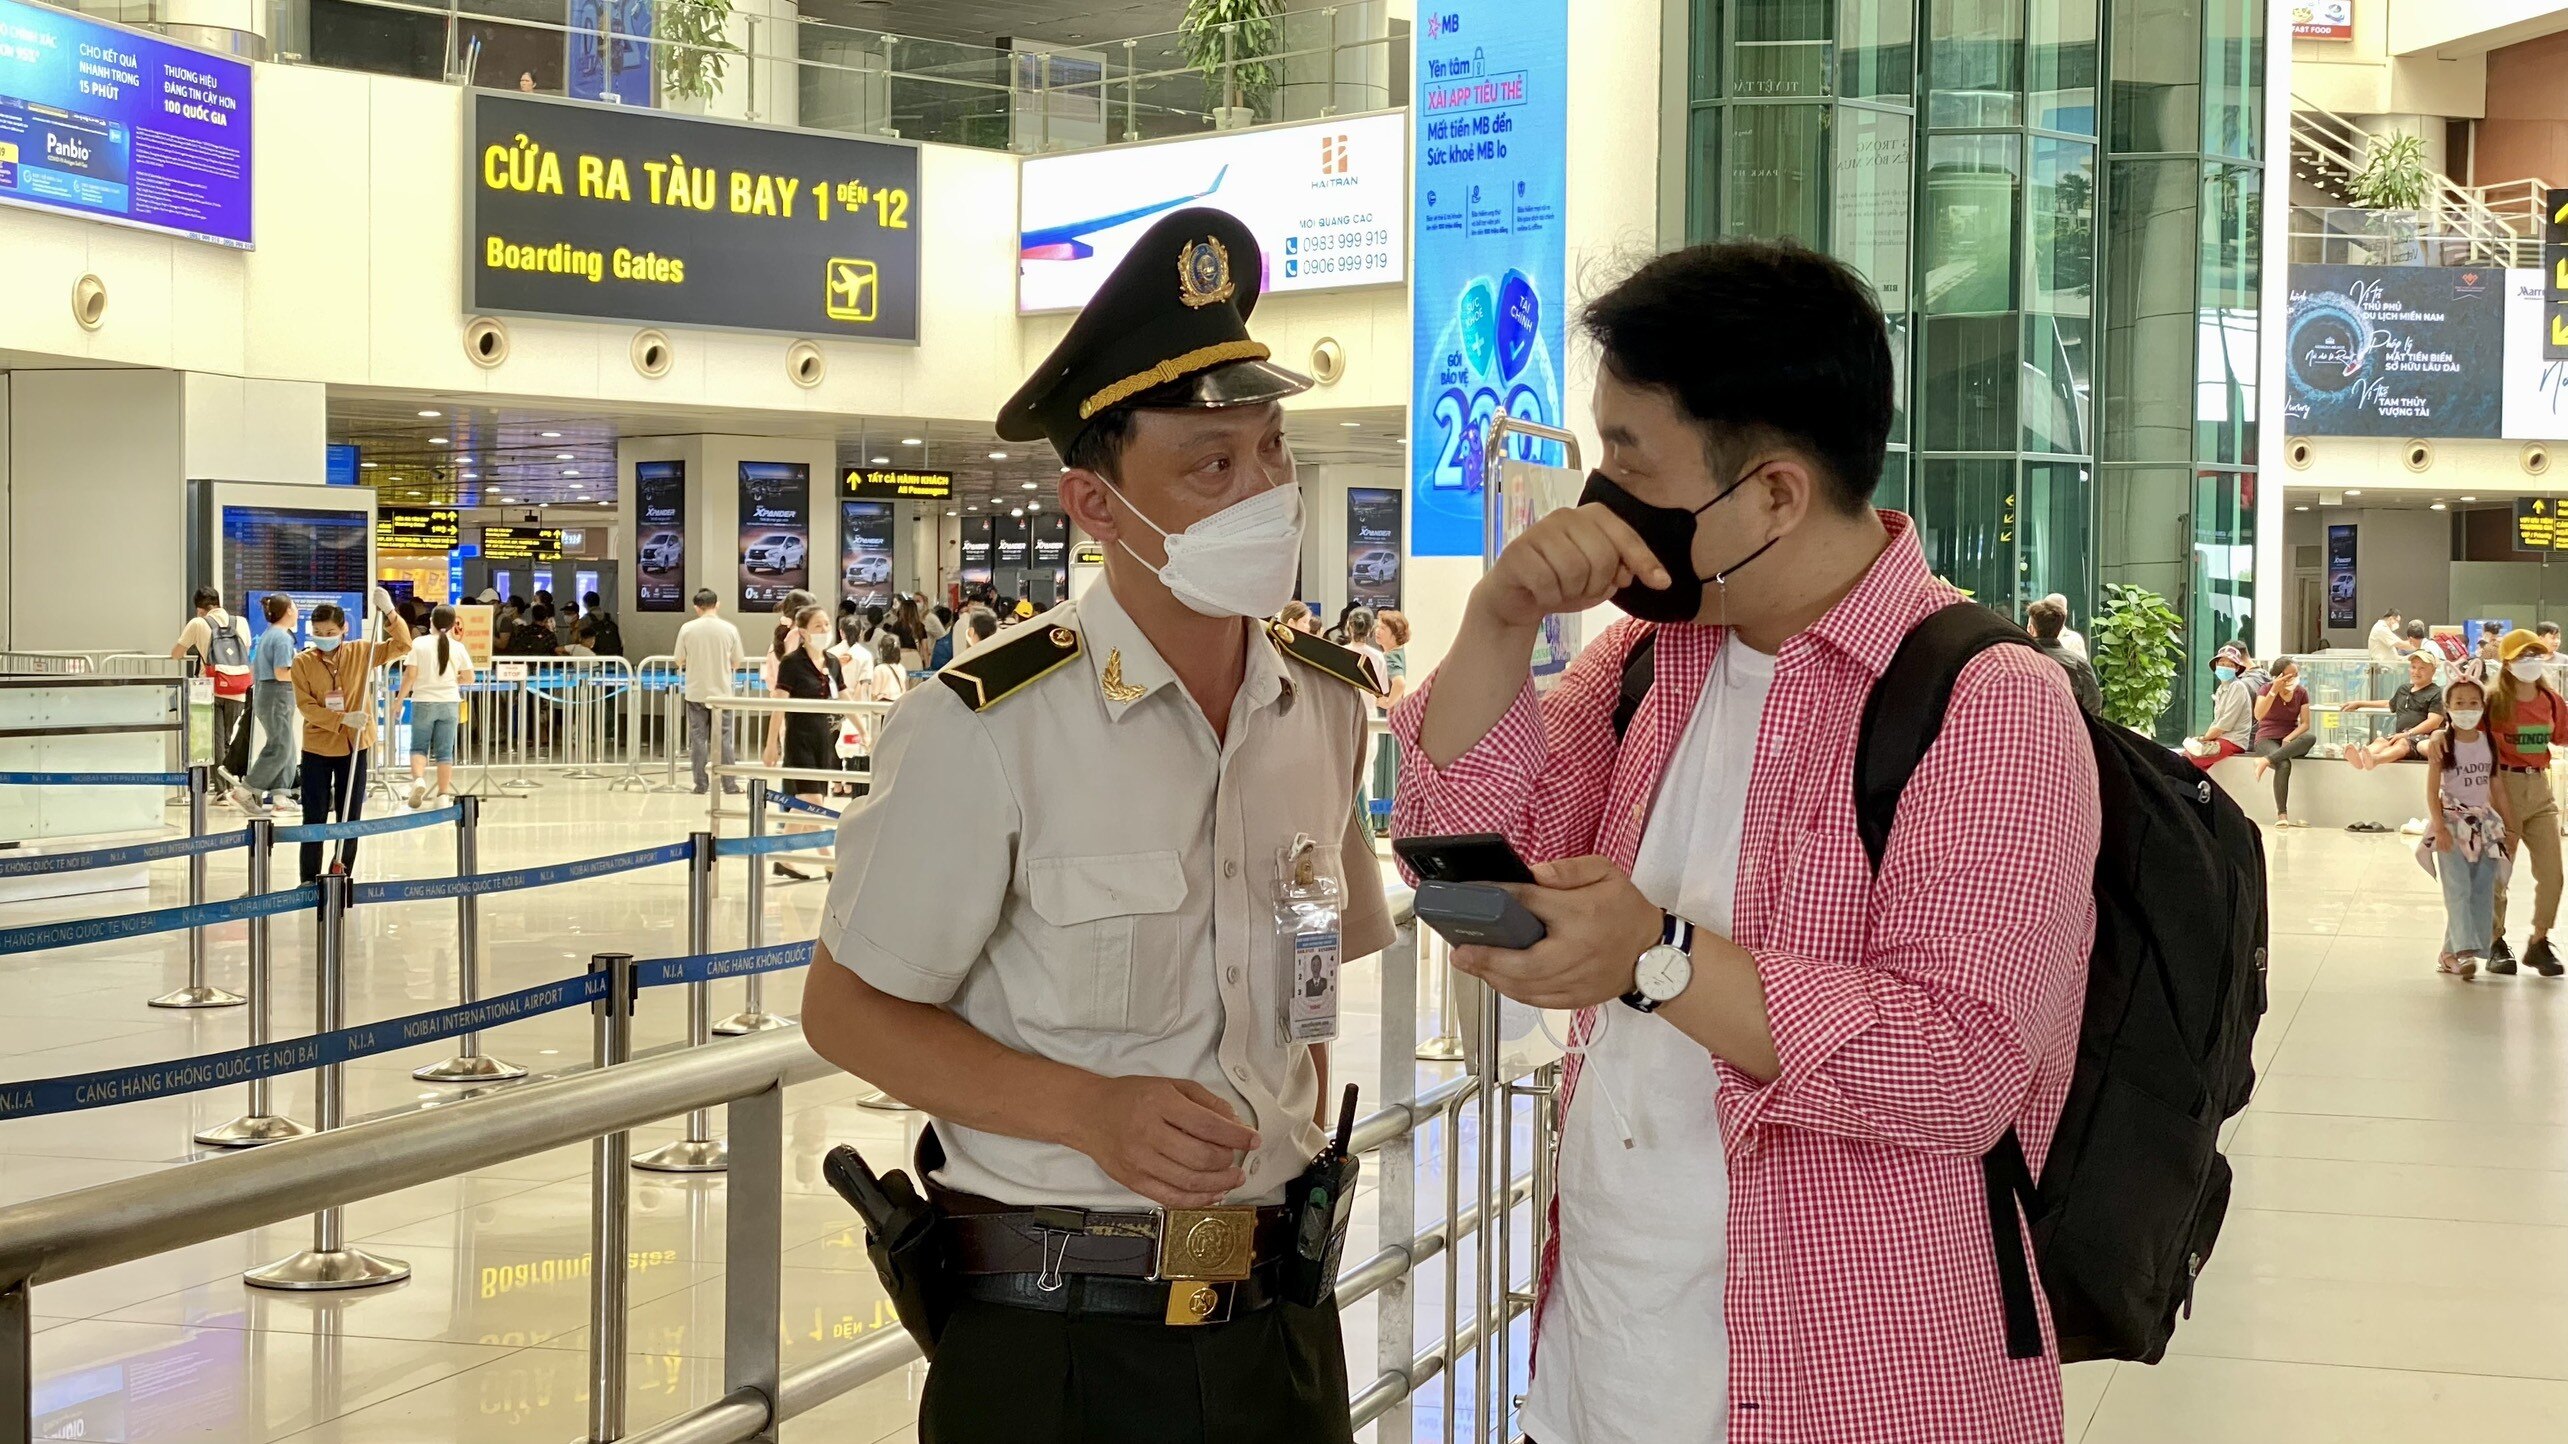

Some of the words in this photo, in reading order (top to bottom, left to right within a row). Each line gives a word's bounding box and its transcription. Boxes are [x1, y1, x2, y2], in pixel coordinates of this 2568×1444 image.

[1442, 14, 1459, 34] MB
[2292, 26, 2308, 34] FAST
[2310, 26, 2332, 34] FOOD
[80, 43, 100, 59] CHO
[103, 47, 118, 63] KẾT
[120, 54, 138, 69] QUẢ
[80, 63, 110, 79] NHANH
[112, 69, 140, 87] TRONG
[164, 64, 198, 83] THƯƠNG
[200, 73, 218, 89] HIỆU
[1428, 57, 1446, 78] Yên
[1449, 57, 1470, 76] tâm
[80, 80, 90, 94] 15
[92, 82, 119, 101] PHÚT
[164, 82, 188, 98] ĐÁNG
[189, 87, 201, 101] TIN
[203, 89, 218, 107] CẬY
[219, 97, 236, 110] HƠN
[1428, 85, 1446, 110] XÀI
[1450, 87, 1470, 107] APP
[1474, 79, 1498, 104] TIÊU
[1501, 74, 1522, 101] THẺ
[164, 100, 181, 115] 100
[183, 102, 208, 122] QUỐC
[211, 111, 227, 126] GIA
[1428, 118, 1448, 141] Mất
[1451, 115, 1470, 138] tiền
[1472, 116, 1490, 136] MB
[47, 133, 89, 161] Panbio
[1428, 146, 1446, 166] Sức
[1477, 141, 1494, 162] MB
[1497, 139, 1507, 159] lo
[484, 133, 563, 195] CỬA
[579, 155, 630, 201] RA
[644, 153, 718, 211] TÀU
[730, 172, 799, 218] BAY
[812, 182, 829, 221] 1
[837, 179, 868, 205] ĐẾN
[872, 188, 909, 229] 12
[1303, 235, 1335, 252] 0983
[1338, 232, 1362, 249] 999
[1366, 229, 1388, 246] 919
[486, 237, 603, 283] Boarding
[613, 247, 685, 284] Gates
[1303, 258, 1335, 275] 0906
[1338, 255, 1362, 272] 999
[1365, 253, 1388, 270] 919
[1520, 295, 1531, 314] TÀI
[2363, 301, 2381, 310] THỦ
[2383, 300, 2402, 310] PHỦ
[1510, 305, 1533, 333] CHÍNH
[2363, 312, 2376, 321] DU
[2378, 312, 2398, 322] LỊCH
[2424, 313, 2444, 322] NAM
[1447, 351, 1462, 367] GÓI
[2385, 360, 2398, 371] SỞ
[2400, 361, 2424, 371] HỮU
[2426, 361, 2441, 372] LÂU
[2443, 361, 2460, 372] DÀI
[2408, 351, 2428, 362] TIỀN
[2430, 350, 2452, 362] BIỂN
[1440, 368, 1457, 386] BẢO
[1458, 367, 1469, 388] VỆ
[2379, 398, 2398, 406] TAM
[2379, 407, 2411, 417] VƯỢNG
[2413, 406, 2429, 416] TÀI
[753, 508, 796, 518] XPANDER
[662, 964, 684, 979] N.I.A
[756, 951, 784, 968] KHÔNG
[165, 1064, 212, 1088] KHÔNG
[216, 1054, 252, 1080] QUỐC
[256, 1045, 271, 1071] TẾ
[274, 1048, 296, 1070] NỘI
[348, 1032, 376, 1051] N.I.A
[404, 1017, 440, 1040] NOIBAI
[442, 1001, 522, 1032] INTERNATIONAL
[524, 987, 564, 1011] AIRPORT
[584, 978, 606, 996] N.I.A
